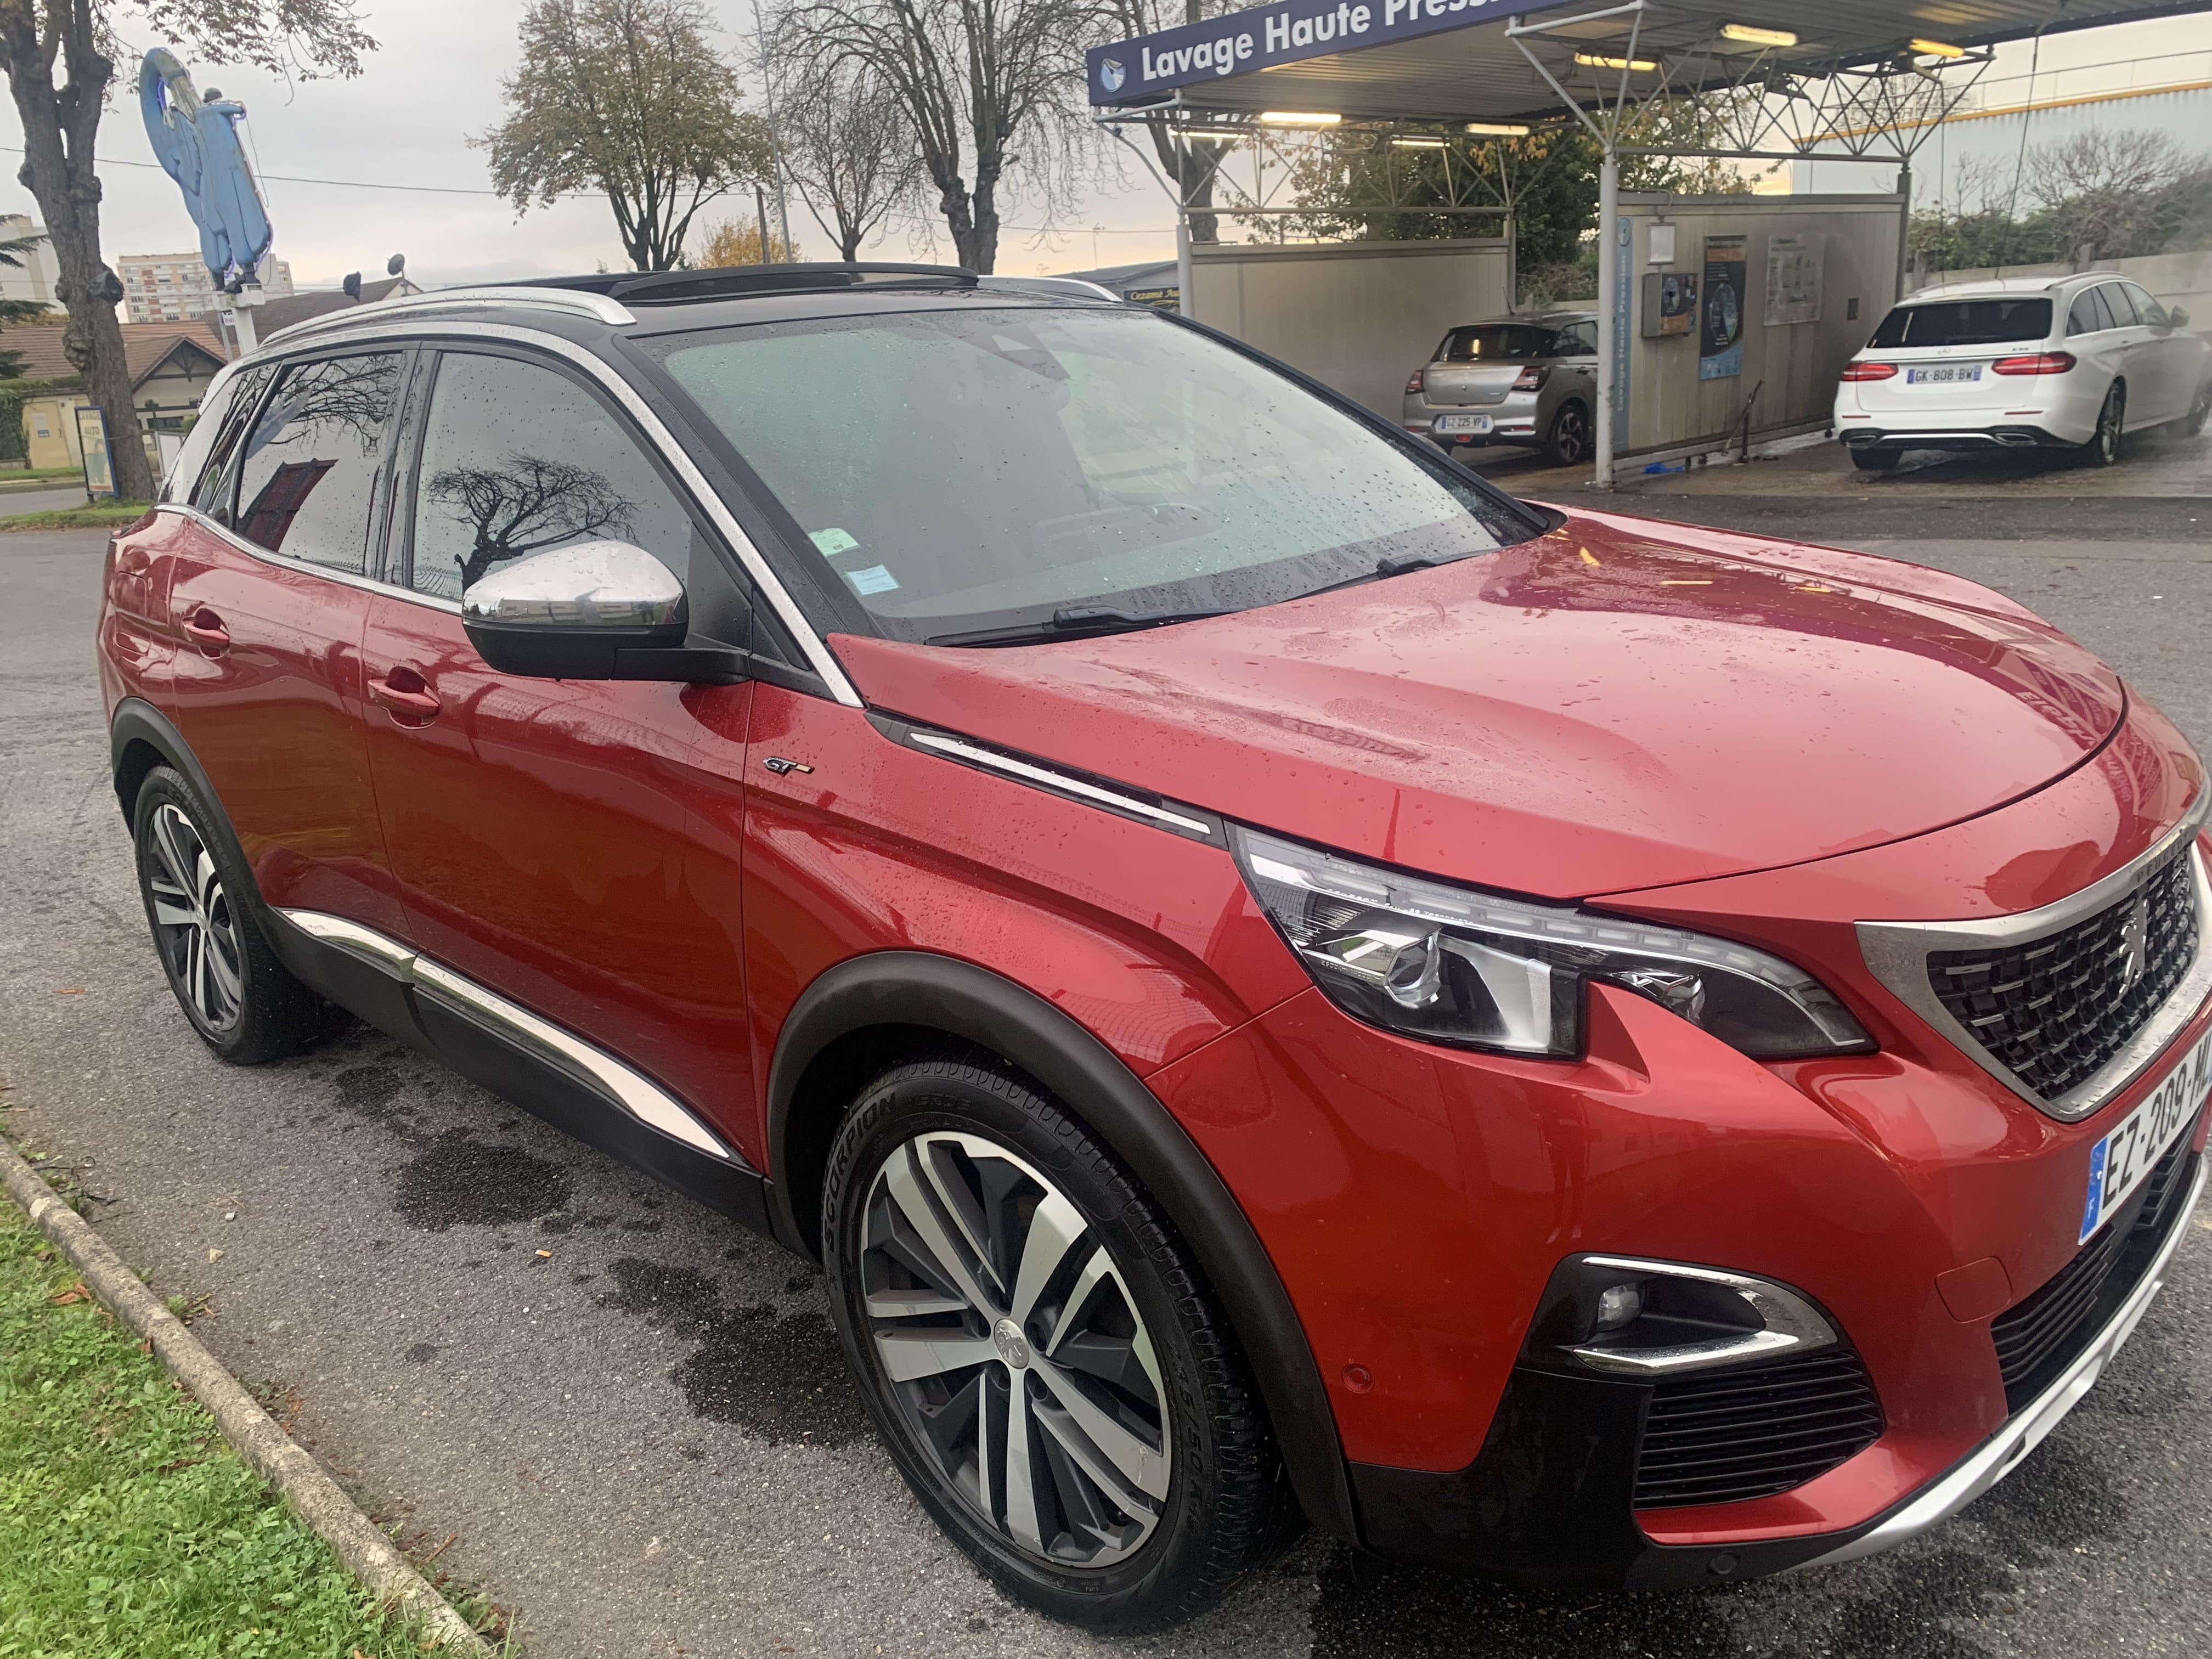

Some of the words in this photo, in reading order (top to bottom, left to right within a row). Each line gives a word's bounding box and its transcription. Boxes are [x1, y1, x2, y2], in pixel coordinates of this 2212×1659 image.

[1141, 33, 1252, 81] Lavage
[1265, 8, 1370, 53] Haute
[1915, 368, 1973, 382] GK-808-BW
[763, 756, 797, 775] GT
[2136, 831, 2187, 883] PEUGEOT
[824, 1092, 896, 1254] SCORPION
